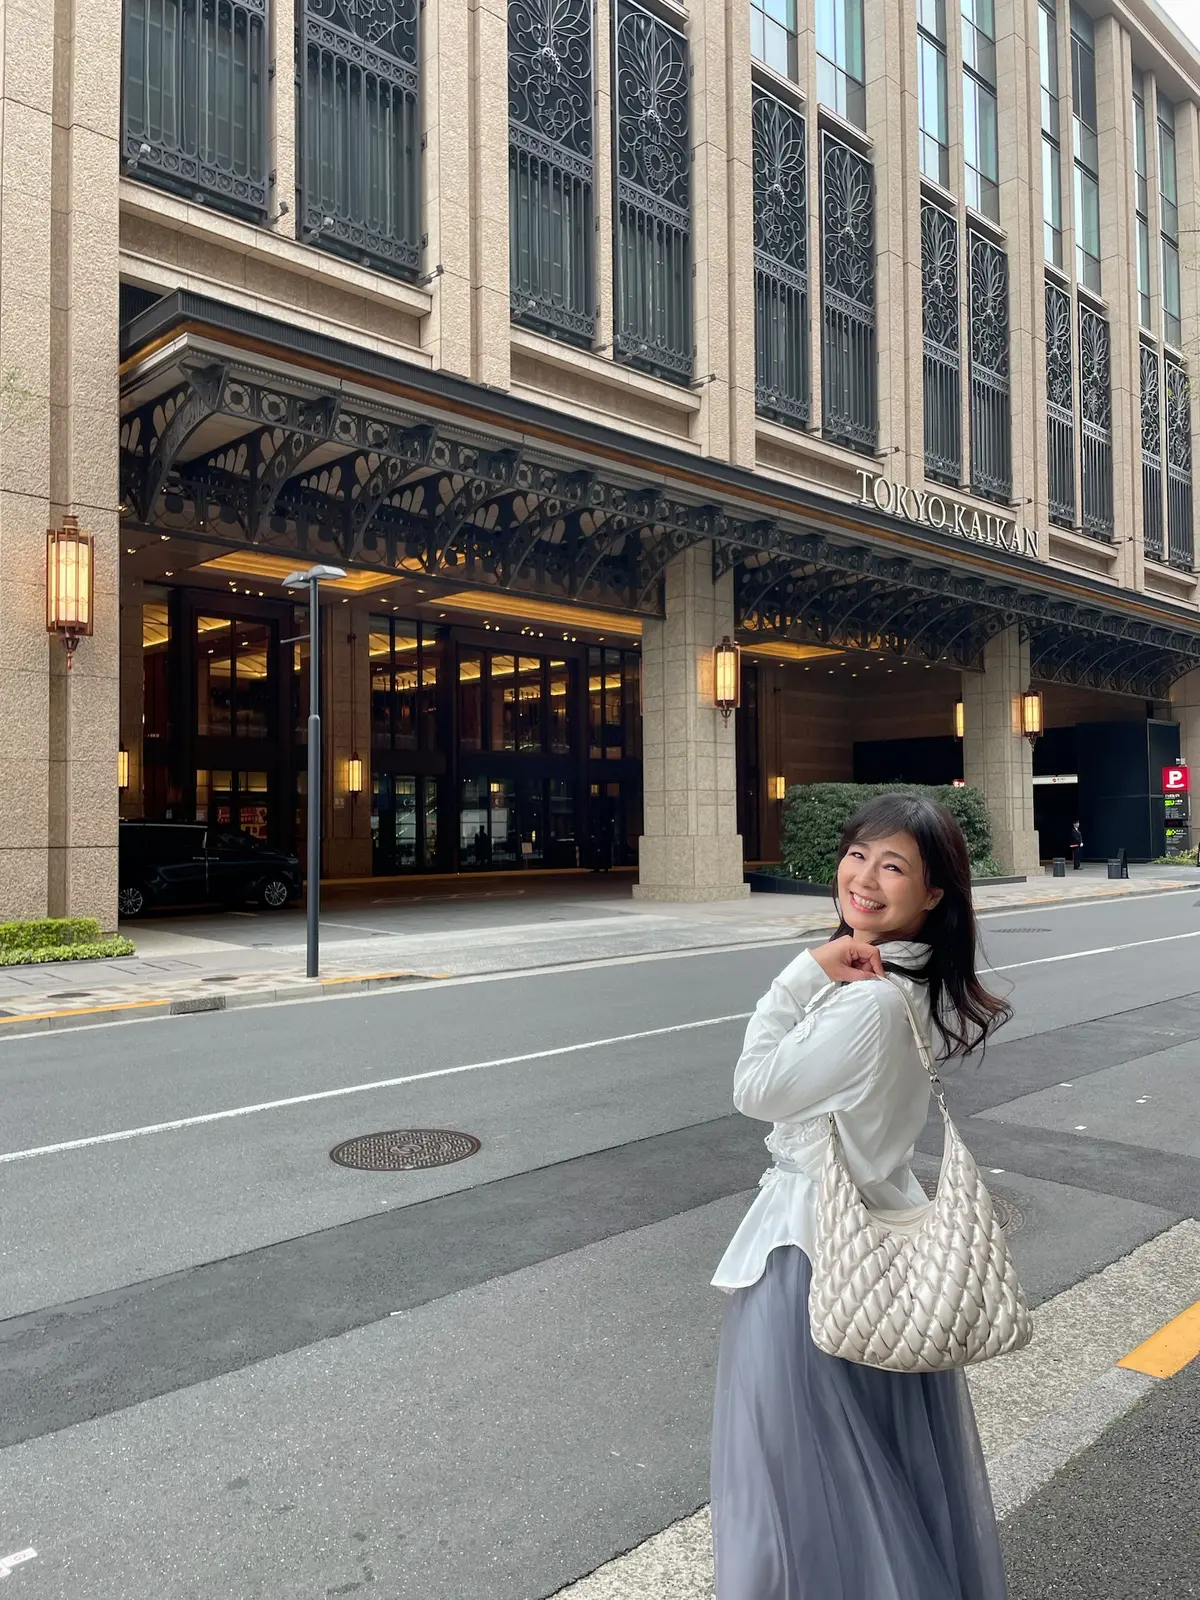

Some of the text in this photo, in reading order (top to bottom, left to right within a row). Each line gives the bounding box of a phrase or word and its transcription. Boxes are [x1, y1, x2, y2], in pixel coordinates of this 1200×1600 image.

[856, 469, 1039, 557] TOKYO KAIKAN
[1168, 770, 1183, 785] P
